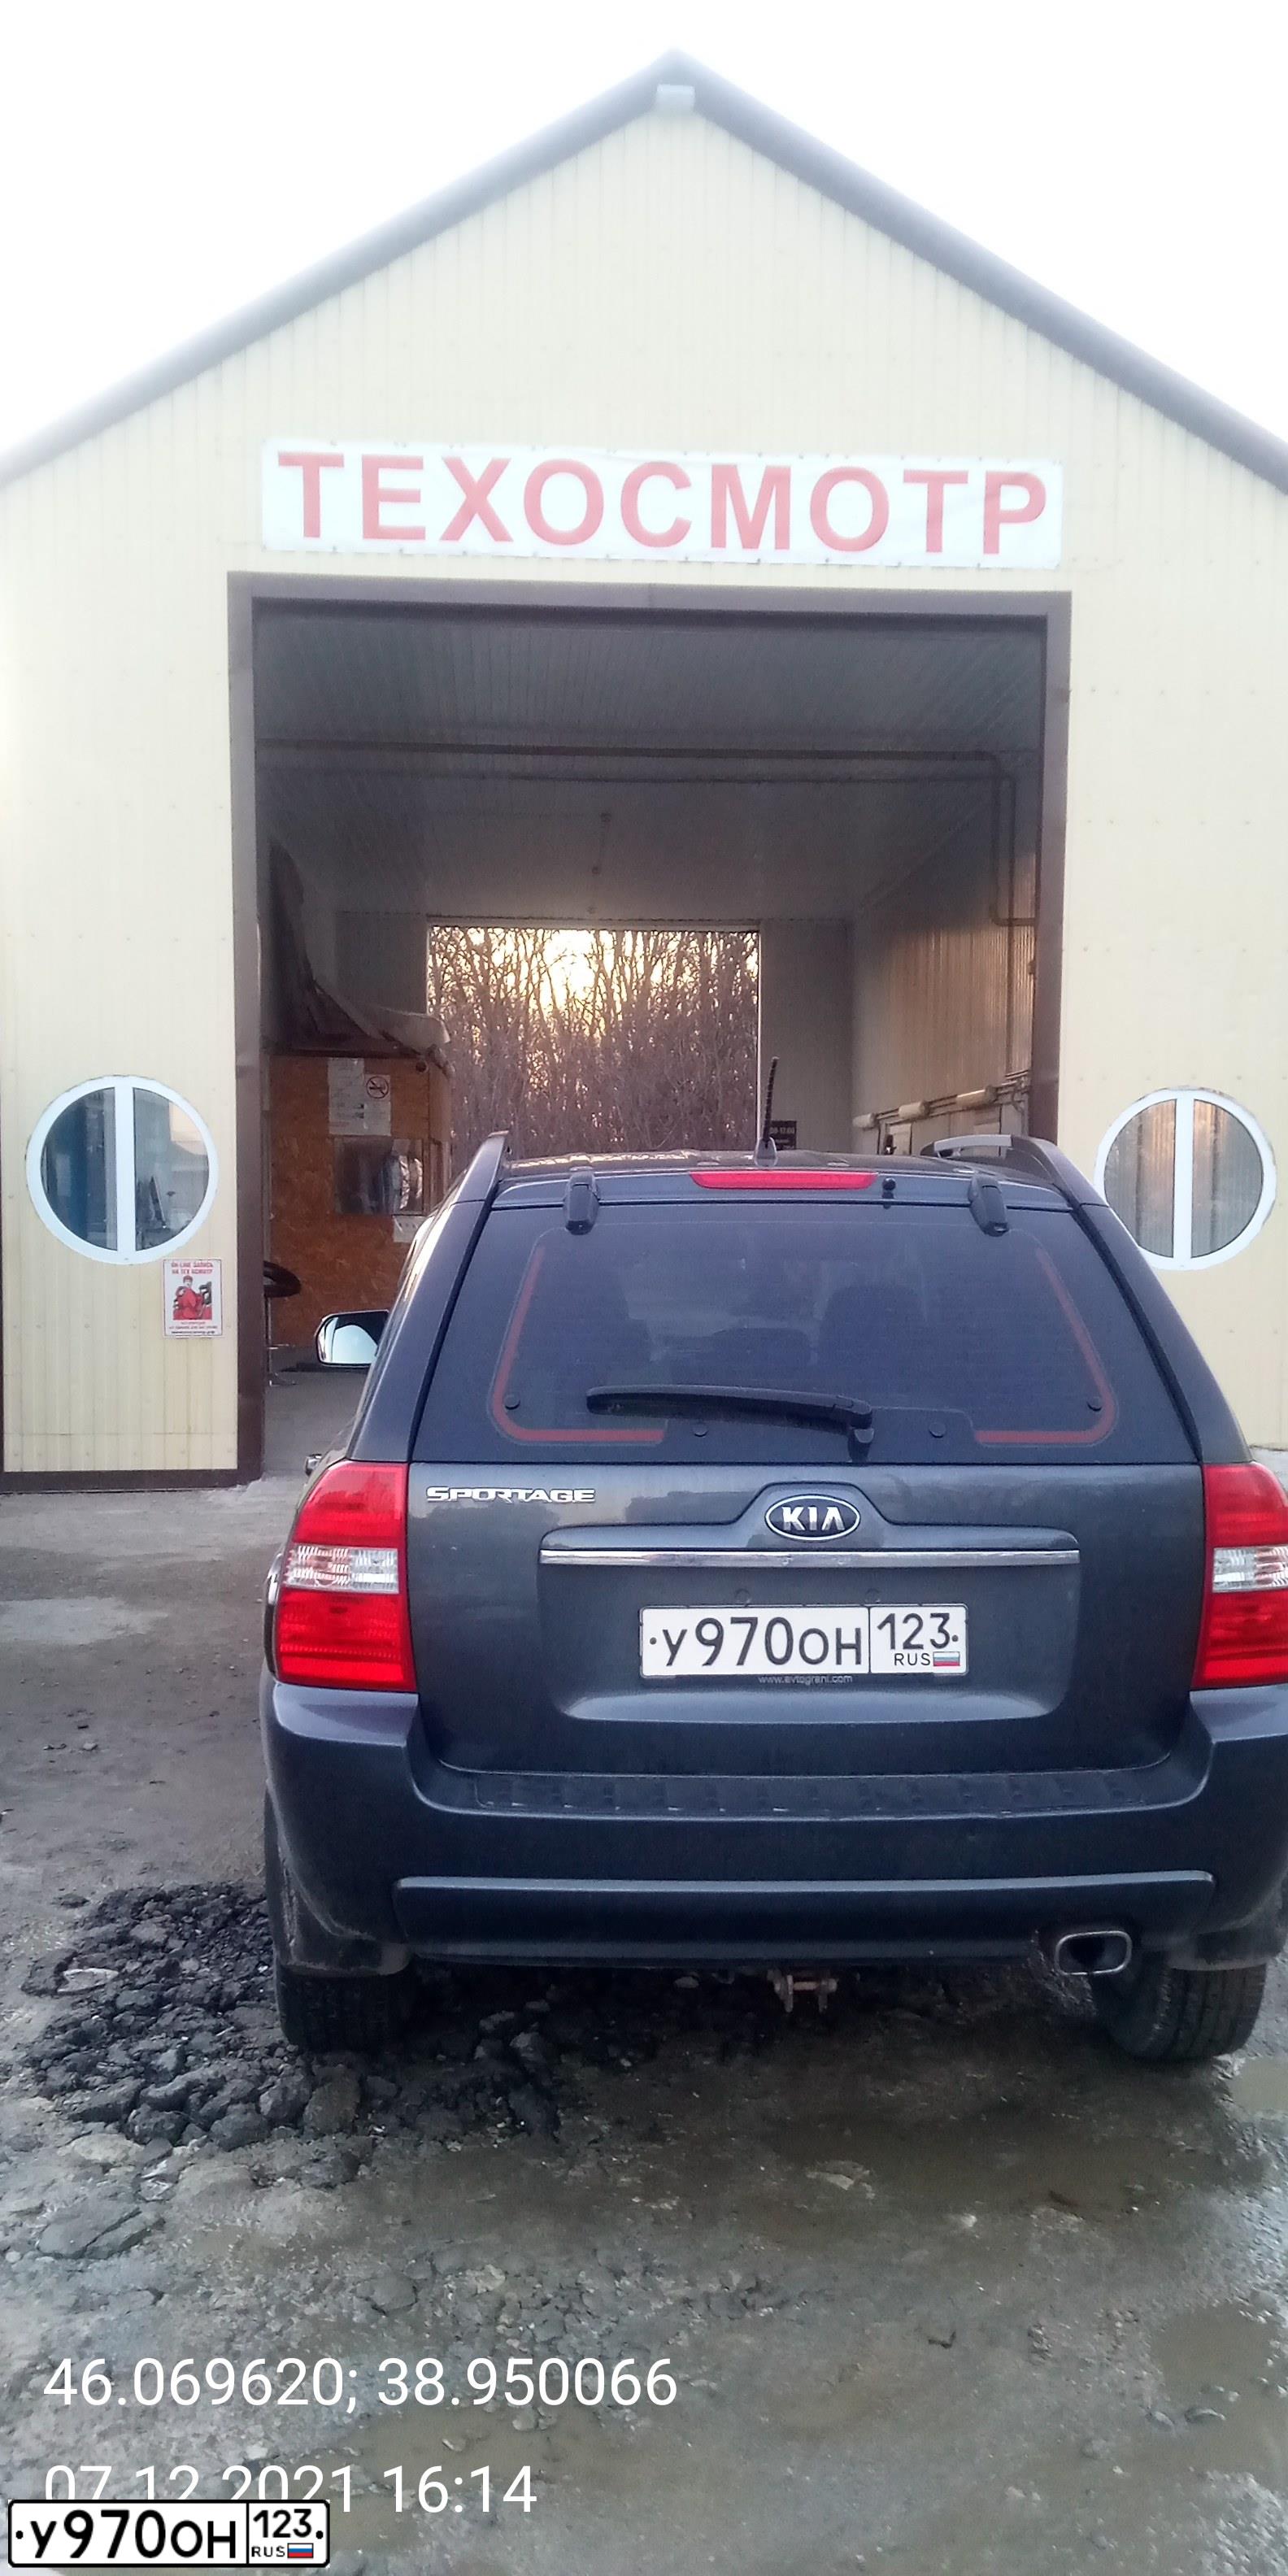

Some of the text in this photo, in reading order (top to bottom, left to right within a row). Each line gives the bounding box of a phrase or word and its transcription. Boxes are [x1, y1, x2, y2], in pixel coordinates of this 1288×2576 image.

[276, 450, 1047, 555] ТЕХОСМОТР
[426, 1486, 596, 1503] SPORTAGE
[781, 1505, 844, 1532] KIA
[661, 1612, 951, 1667] У970ОН 123
[894, 1652, 931, 1667] RUS
